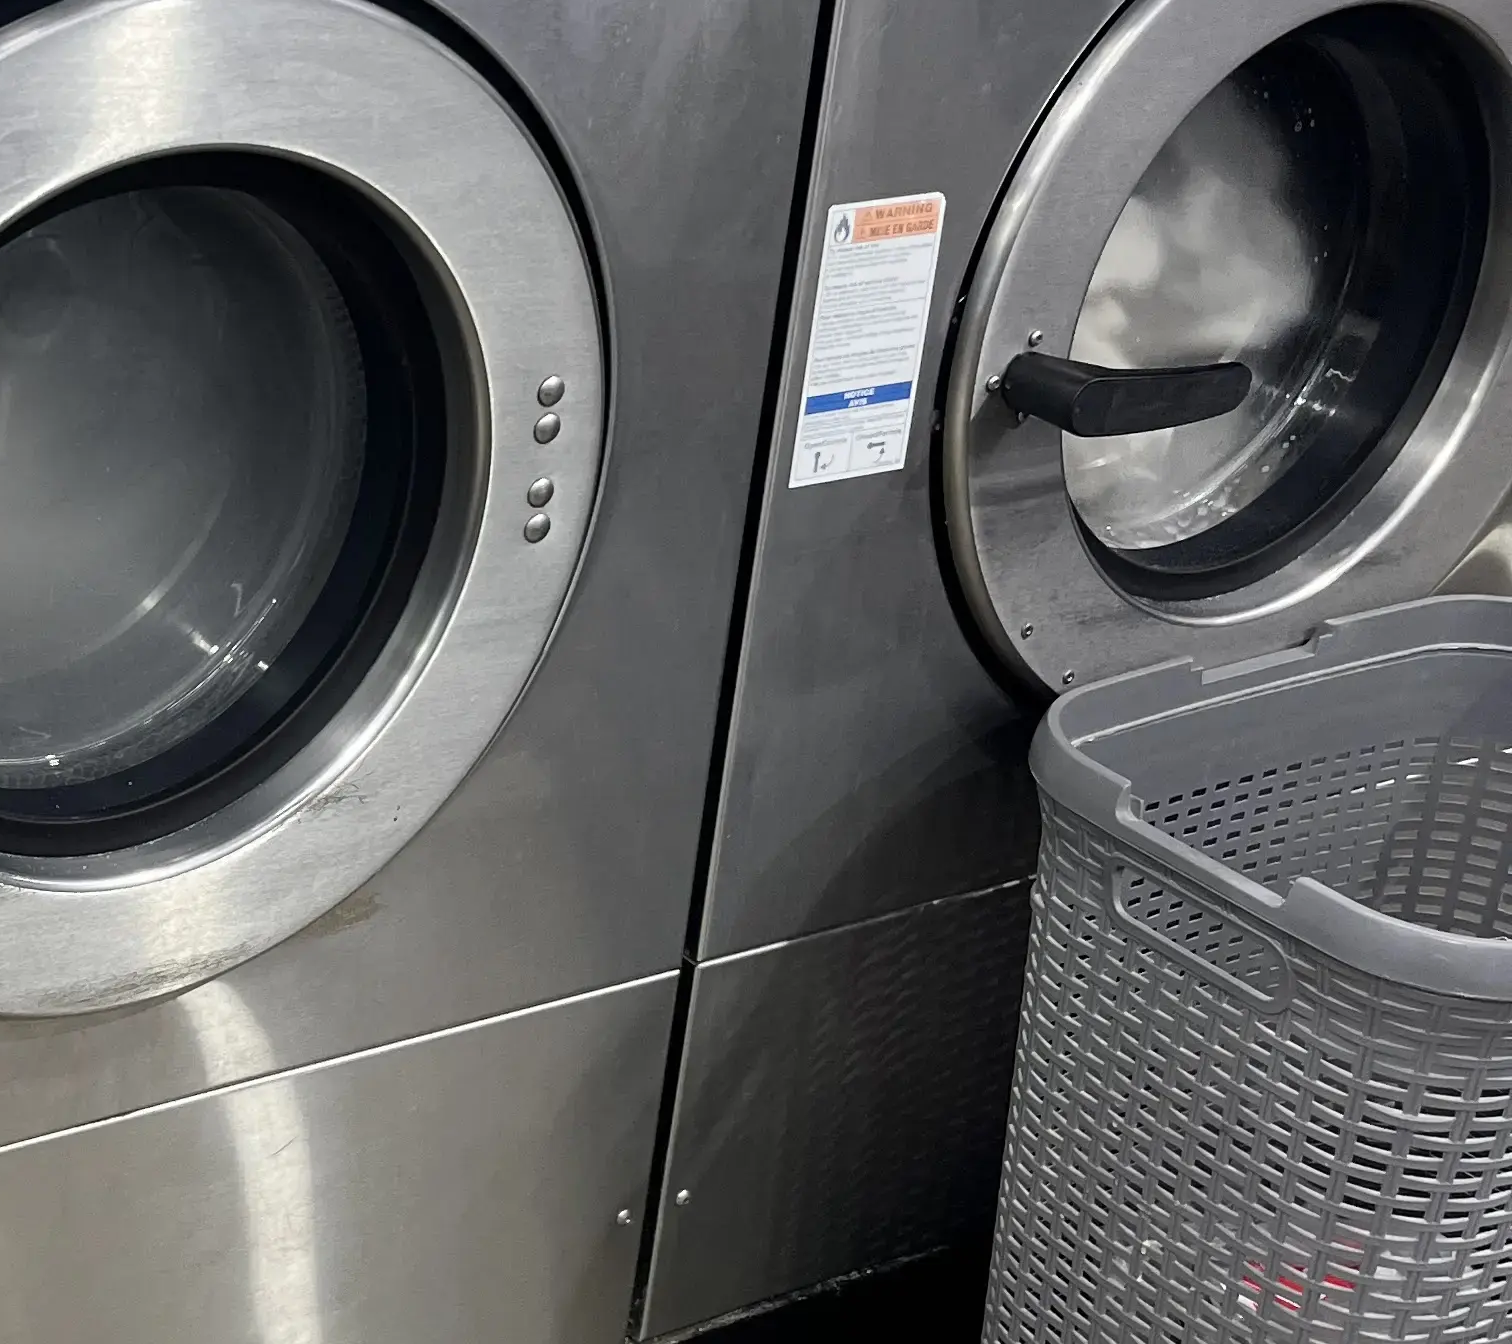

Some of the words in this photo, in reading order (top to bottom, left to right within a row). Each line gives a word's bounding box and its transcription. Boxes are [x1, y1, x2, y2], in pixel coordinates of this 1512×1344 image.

[875, 202, 933, 219] WARNING
[892, 223, 904, 234] EN
[905, 219, 935, 233] GARDE
[843, 387, 876, 400] NOTICE
